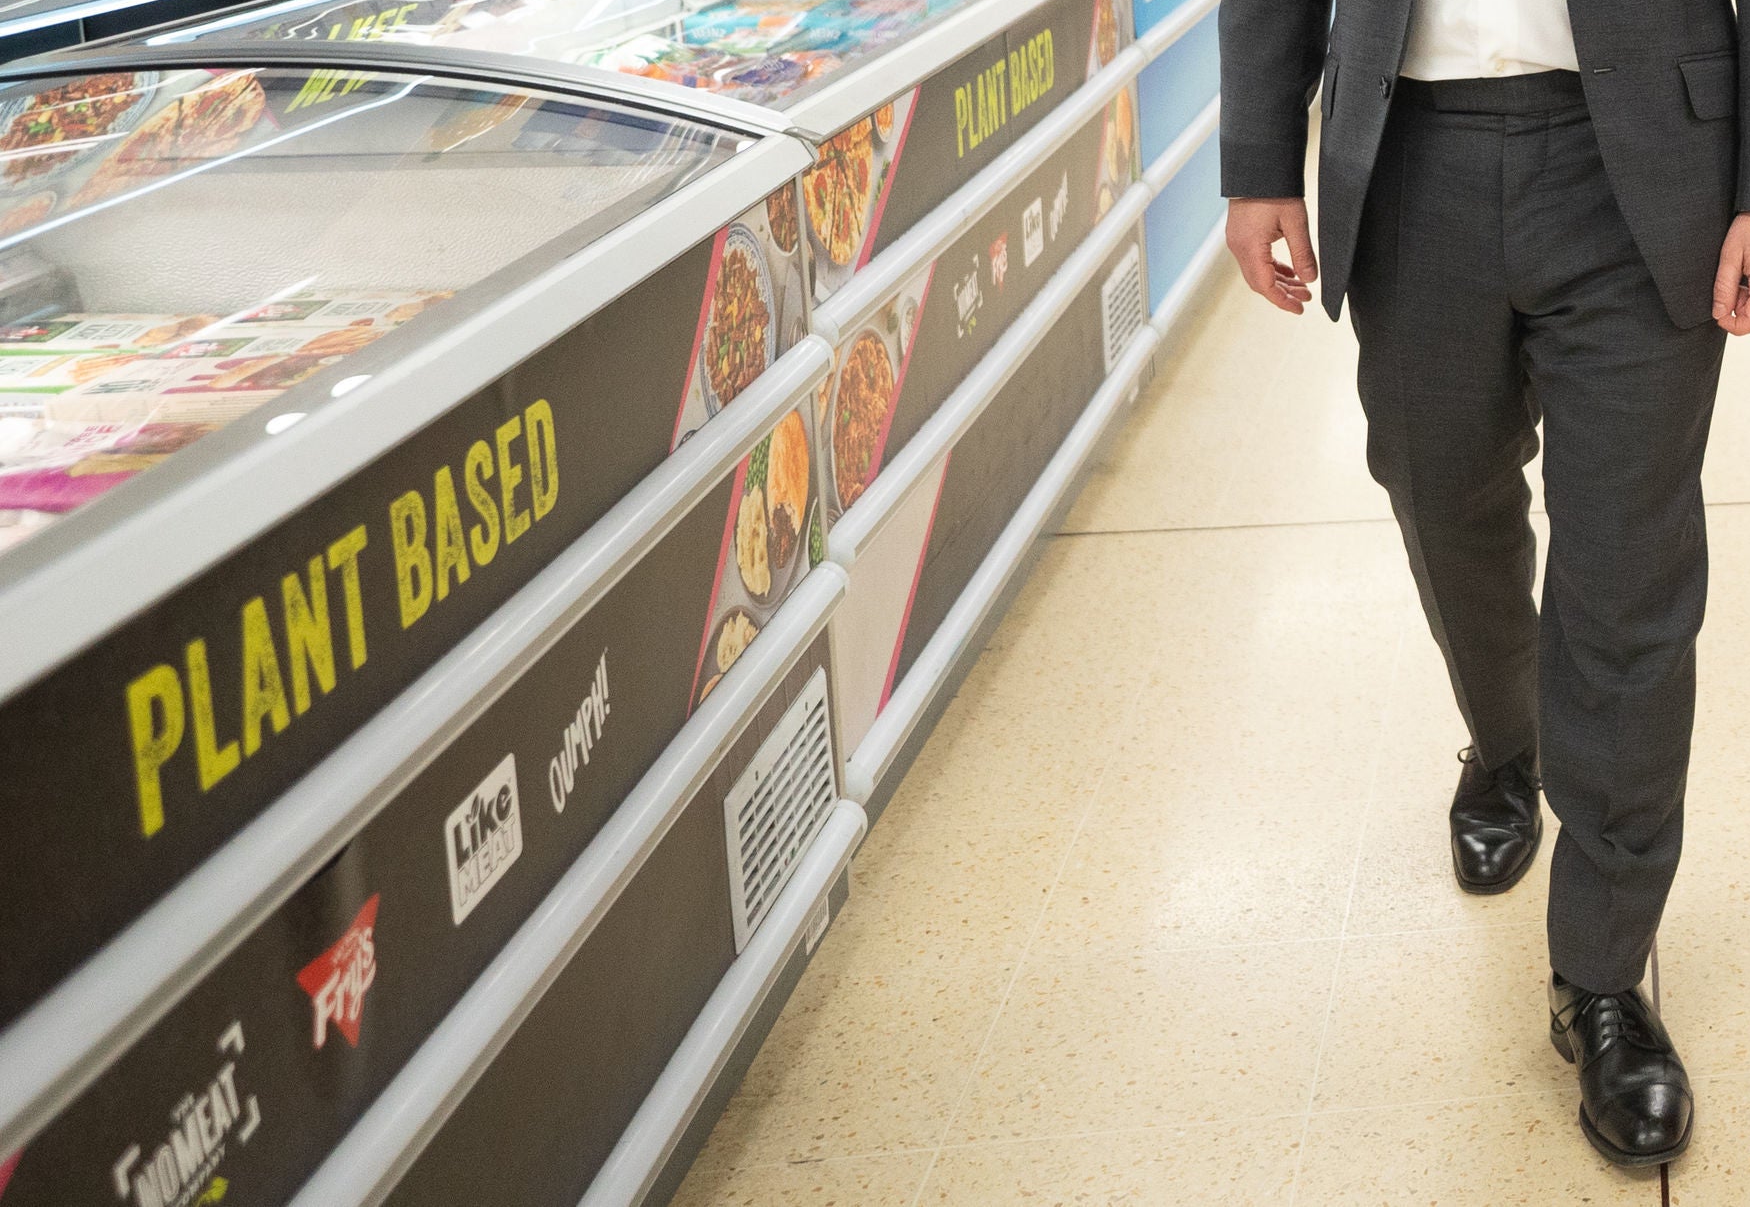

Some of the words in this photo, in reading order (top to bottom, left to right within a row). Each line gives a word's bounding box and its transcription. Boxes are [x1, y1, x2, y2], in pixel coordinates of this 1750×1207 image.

[955, 59, 1006, 158] PLANT
[1010, 28, 1054, 116] BASED
[126, 524, 367, 838] PLANT
[390, 398, 560, 630] BASED
[550, 652, 611, 814] OUMPH!
[454, 784, 513, 870] Like
[457, 813, 516, 907] MEAT
